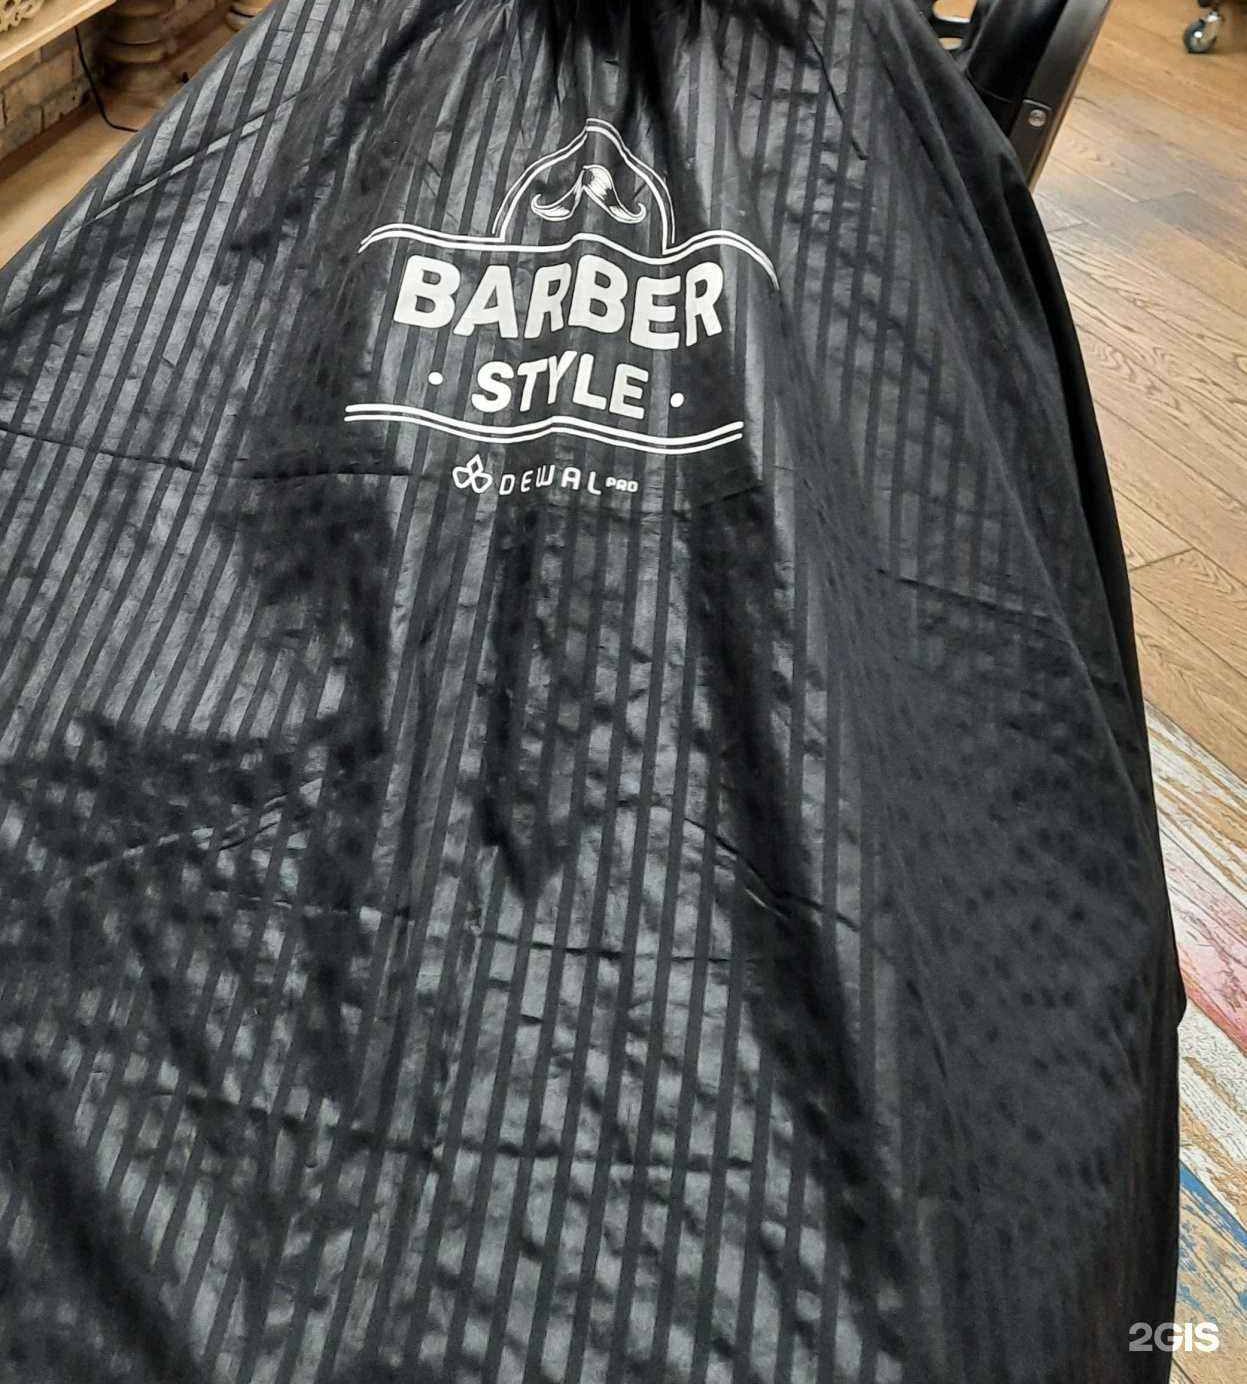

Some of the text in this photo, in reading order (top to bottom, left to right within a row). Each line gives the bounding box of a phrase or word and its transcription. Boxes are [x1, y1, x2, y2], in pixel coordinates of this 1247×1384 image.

[393, 254, 725, 351] BARBER
[471, 350, 650, 420] STYLE
[499, 464, 602, 496] DEWAL
